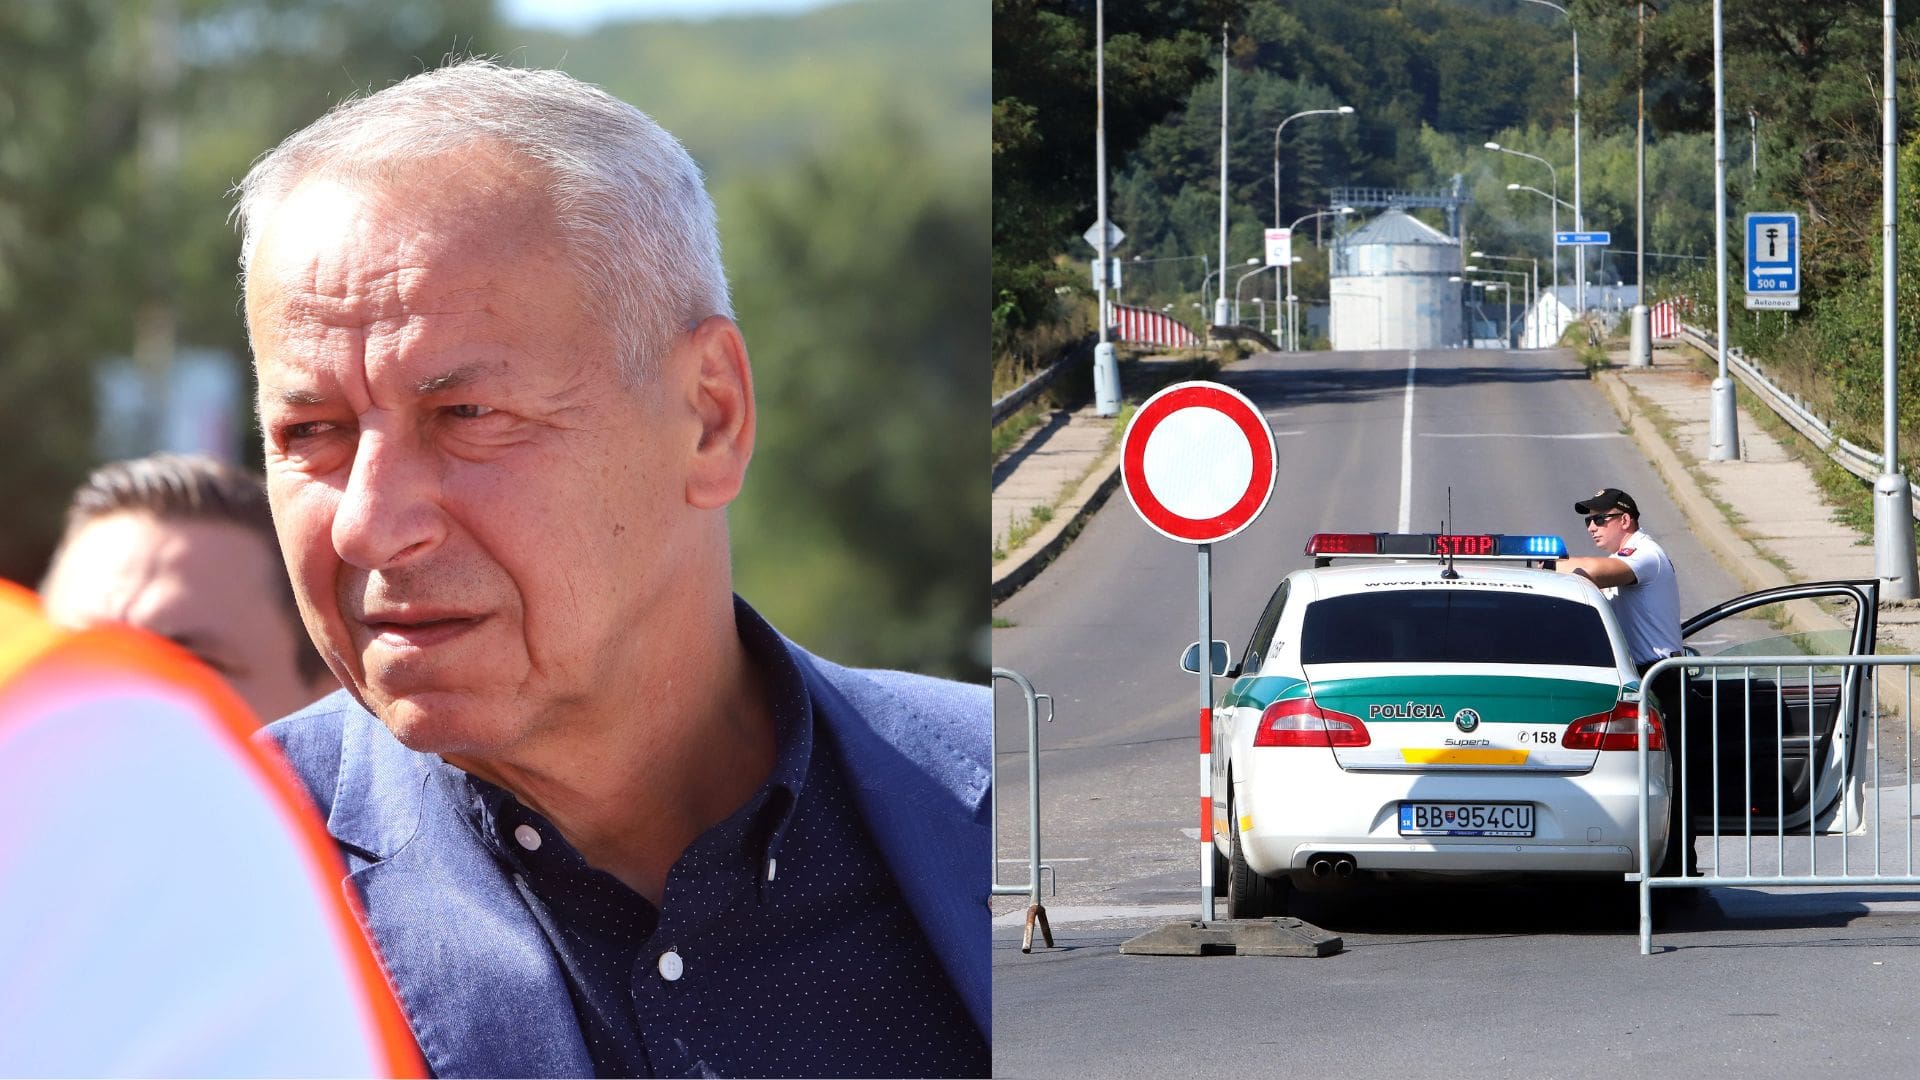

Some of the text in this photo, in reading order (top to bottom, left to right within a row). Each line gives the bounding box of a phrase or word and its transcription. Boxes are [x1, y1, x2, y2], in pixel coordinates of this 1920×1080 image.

[1757, 279, 1788, 289] 500 m
[1436, 535, 1493, 555] STOP
[1364, 580, 1534, 590] www.policiasr.sk
[1369, 701, 1445, 719] POLÍCIA
[1443, 738, 1491, 747] Superb
[1531, 731, 1557, 744] 158
[1415, 806, 1530, 829] BB 954CU
